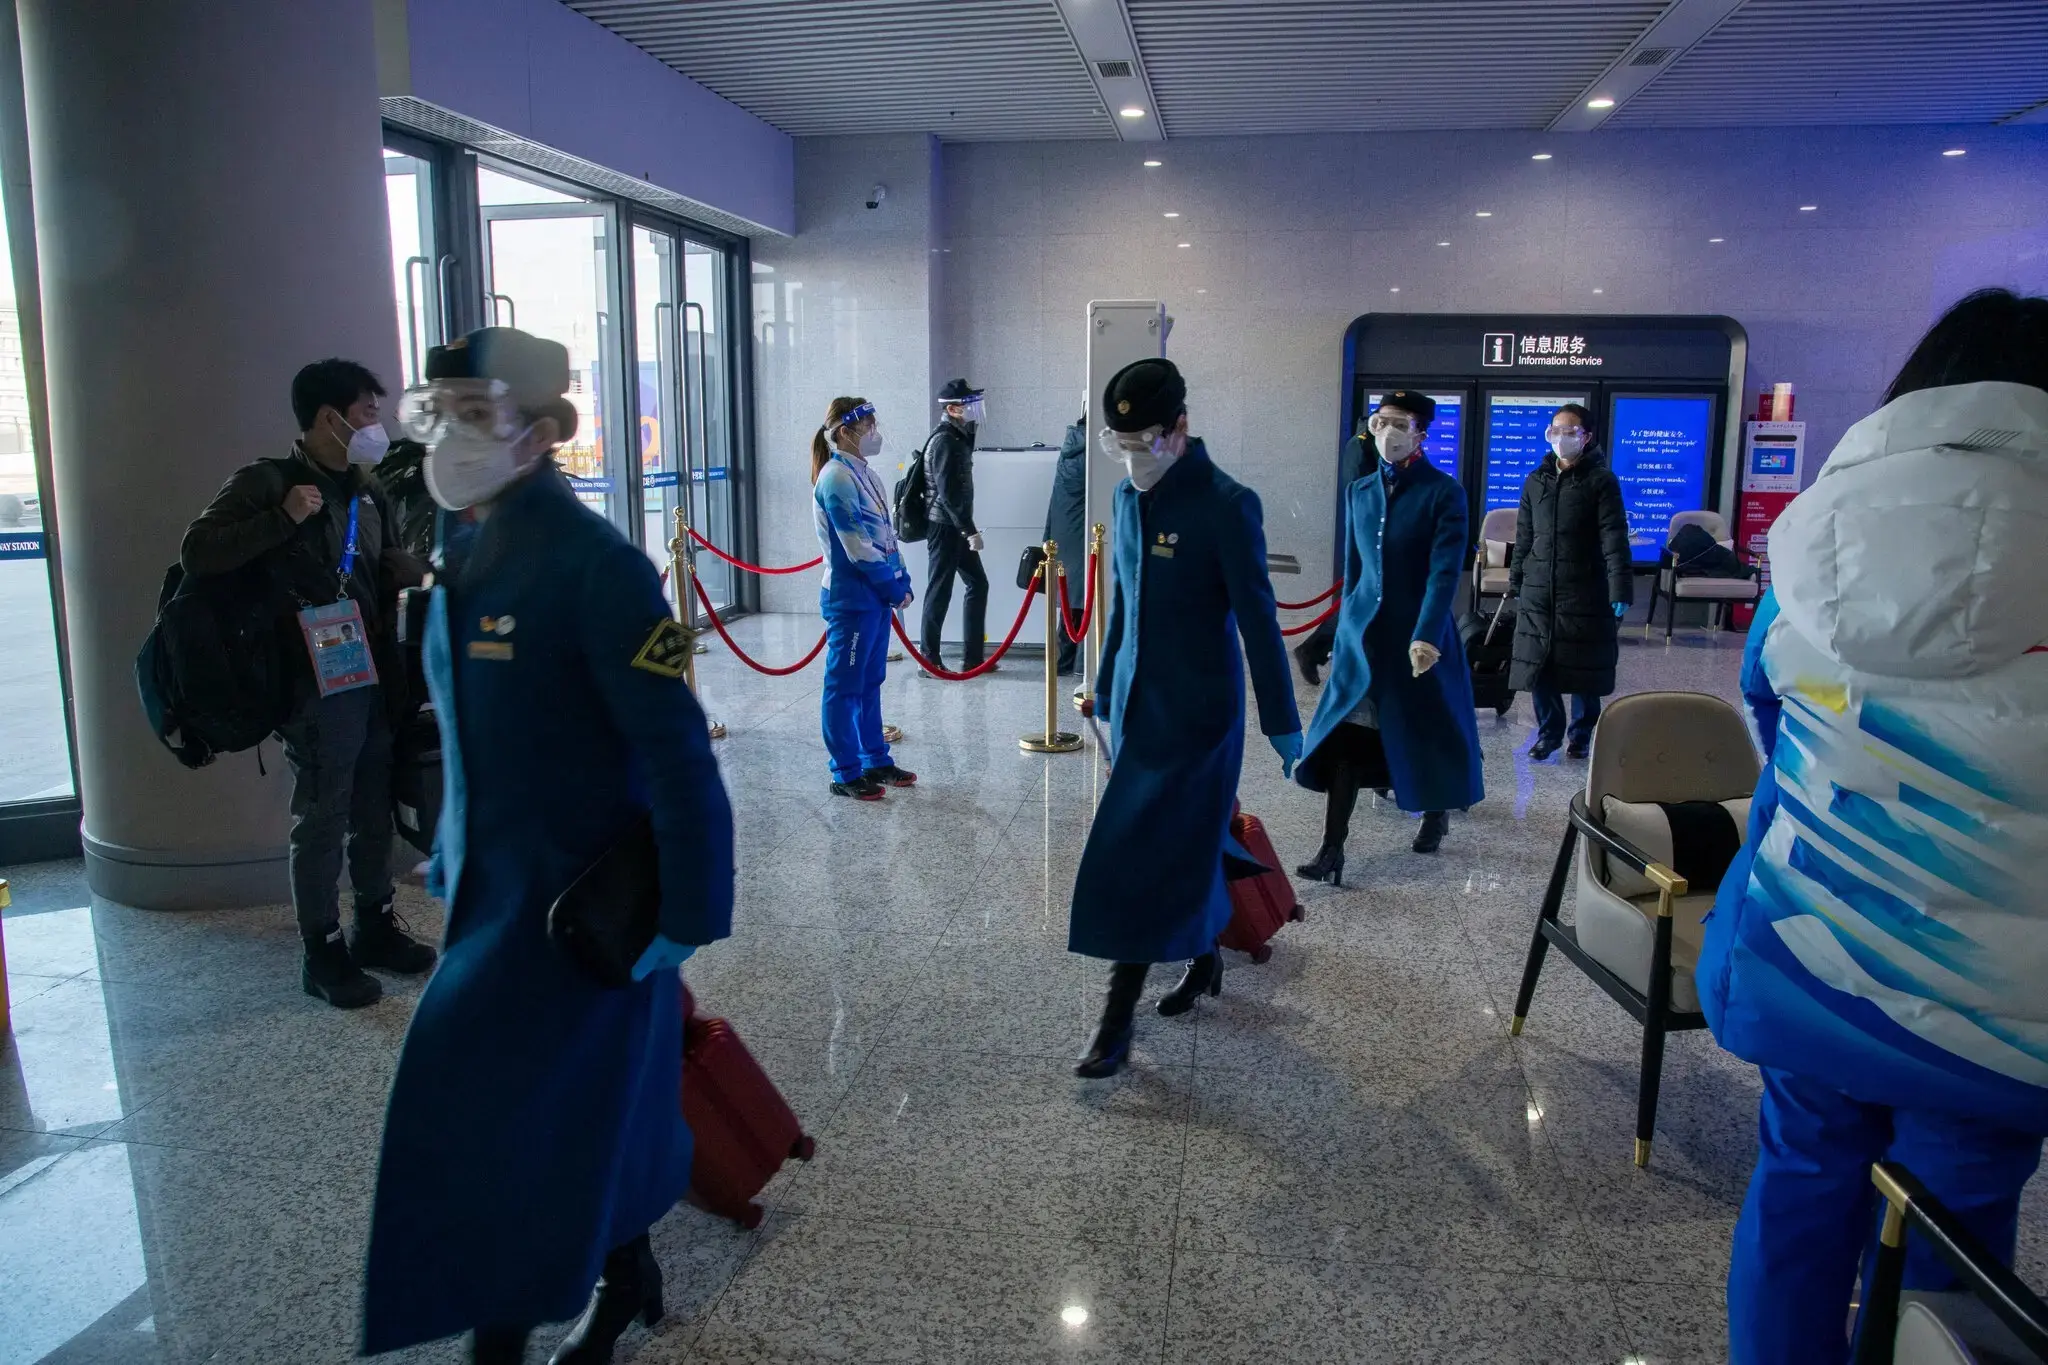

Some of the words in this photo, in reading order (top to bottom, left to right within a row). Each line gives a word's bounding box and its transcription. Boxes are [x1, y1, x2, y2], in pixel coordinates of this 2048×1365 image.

[1520, 335, 1586, 354] 信息服务
[1518, 355, 1567, 366] Information
[1569, 355, 1603, 366] Service
[12, 541, 40, 551] STATION
